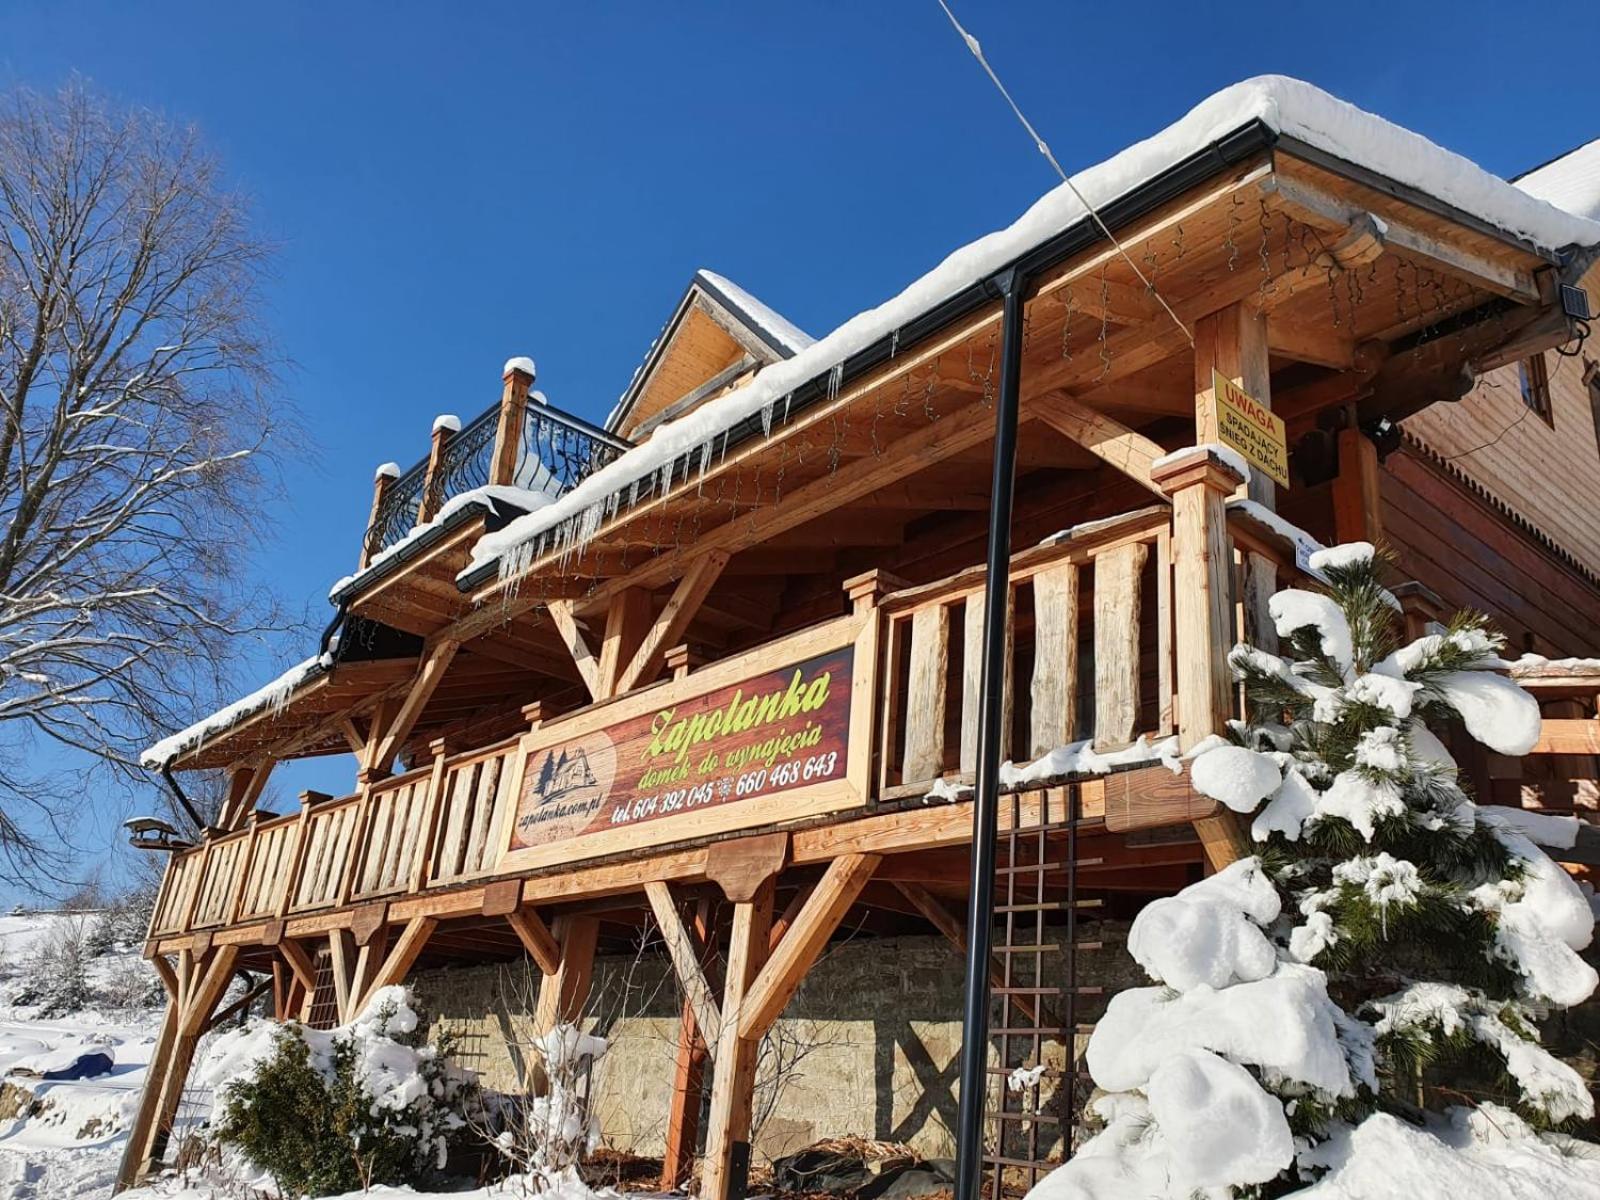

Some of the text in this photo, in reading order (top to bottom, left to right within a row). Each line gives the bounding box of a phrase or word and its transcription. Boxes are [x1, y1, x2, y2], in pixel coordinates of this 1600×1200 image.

[1225, 384, 1276, 434] UWAGA
[1220, 421, 1287, 479] ŚNIEG Z DACHU
[640, 668, 831, 764] Zapolanka
[610, 752, 837, 824] tel. 604 392 045 660 468 643
[638, 724, 822, 790] domek do wynajęcia
[518, 792, 603, 833] zapolanka.com.pl
